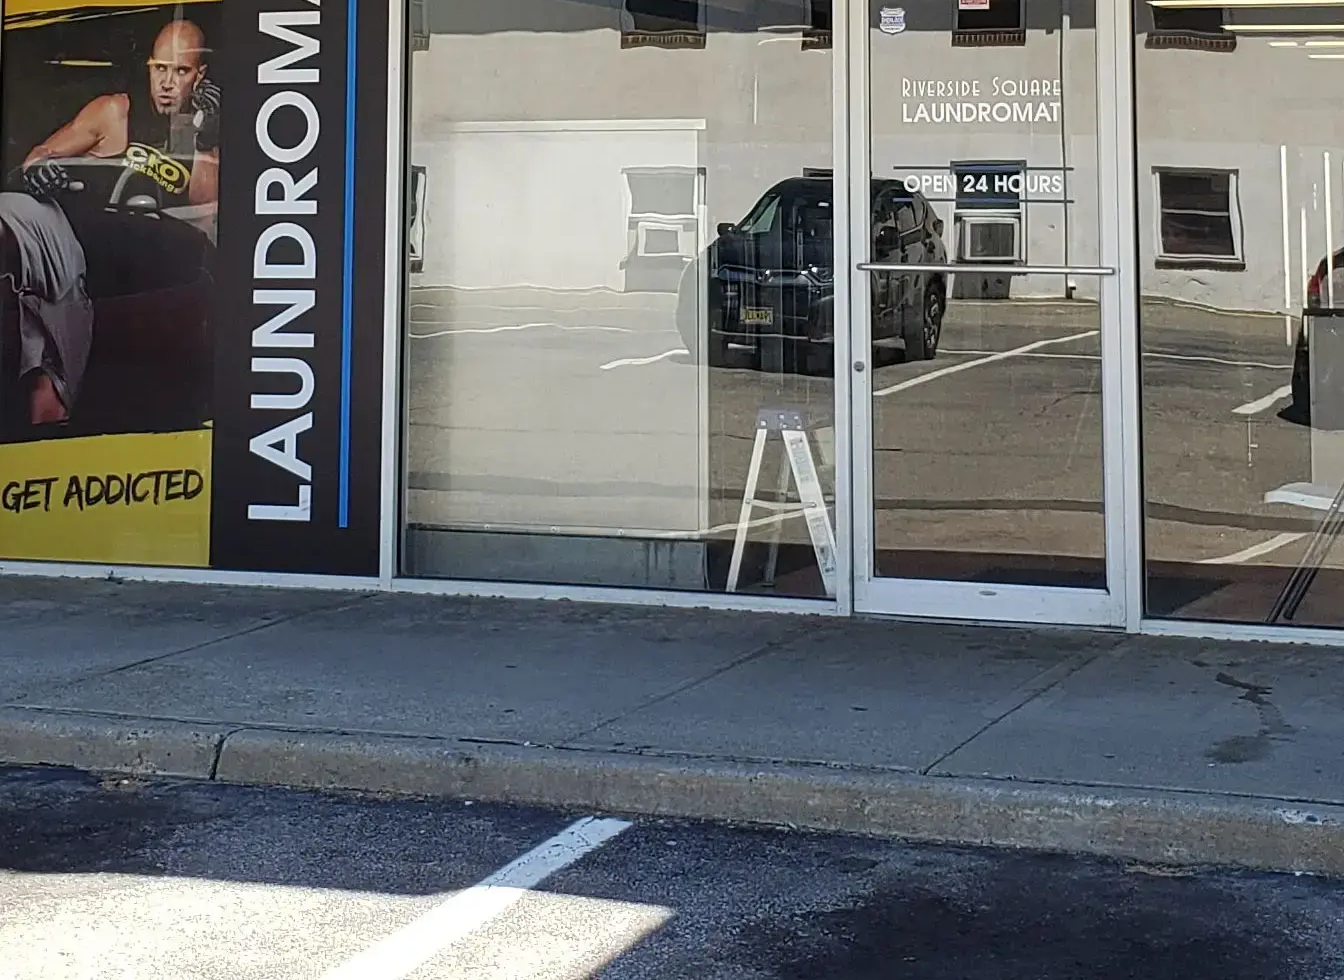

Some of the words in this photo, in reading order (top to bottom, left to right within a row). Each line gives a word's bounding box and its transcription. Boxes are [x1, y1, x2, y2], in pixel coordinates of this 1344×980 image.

[902, 77, 981, 98] RIVERSIDE
[992, 76, 1061, 97] SQUARE
[902, 102, 1061, 123] LAUNDROMAT
[126, 146, 181, 183] CKO
[903, 174, 958, 194] OPEN
[963, 175, 989, 194] 24
[995, 174, 1063, 194] HOURS
[2, 477, 60, 514] GET
[63, 468, 204, 513] ADDICTED
